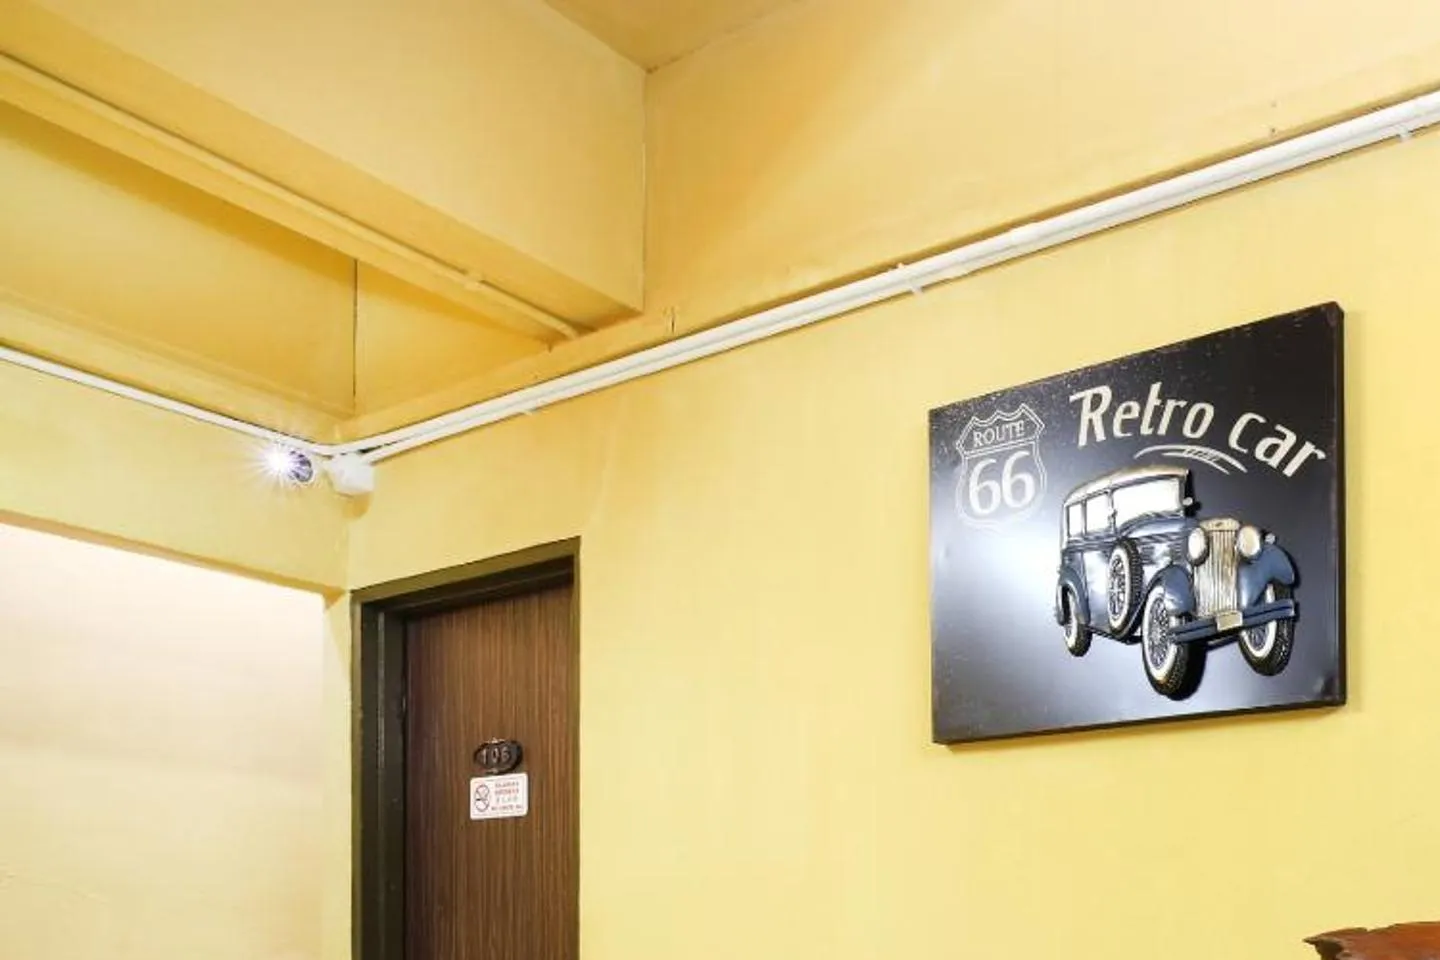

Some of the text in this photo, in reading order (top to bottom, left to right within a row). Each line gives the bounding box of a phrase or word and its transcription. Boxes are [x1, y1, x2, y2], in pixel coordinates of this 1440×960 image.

[972, 419, 1025, 449] ROUTE
[1069, 381, 1327, 478] Retro car
[967, 451, 1036, 516] 66
